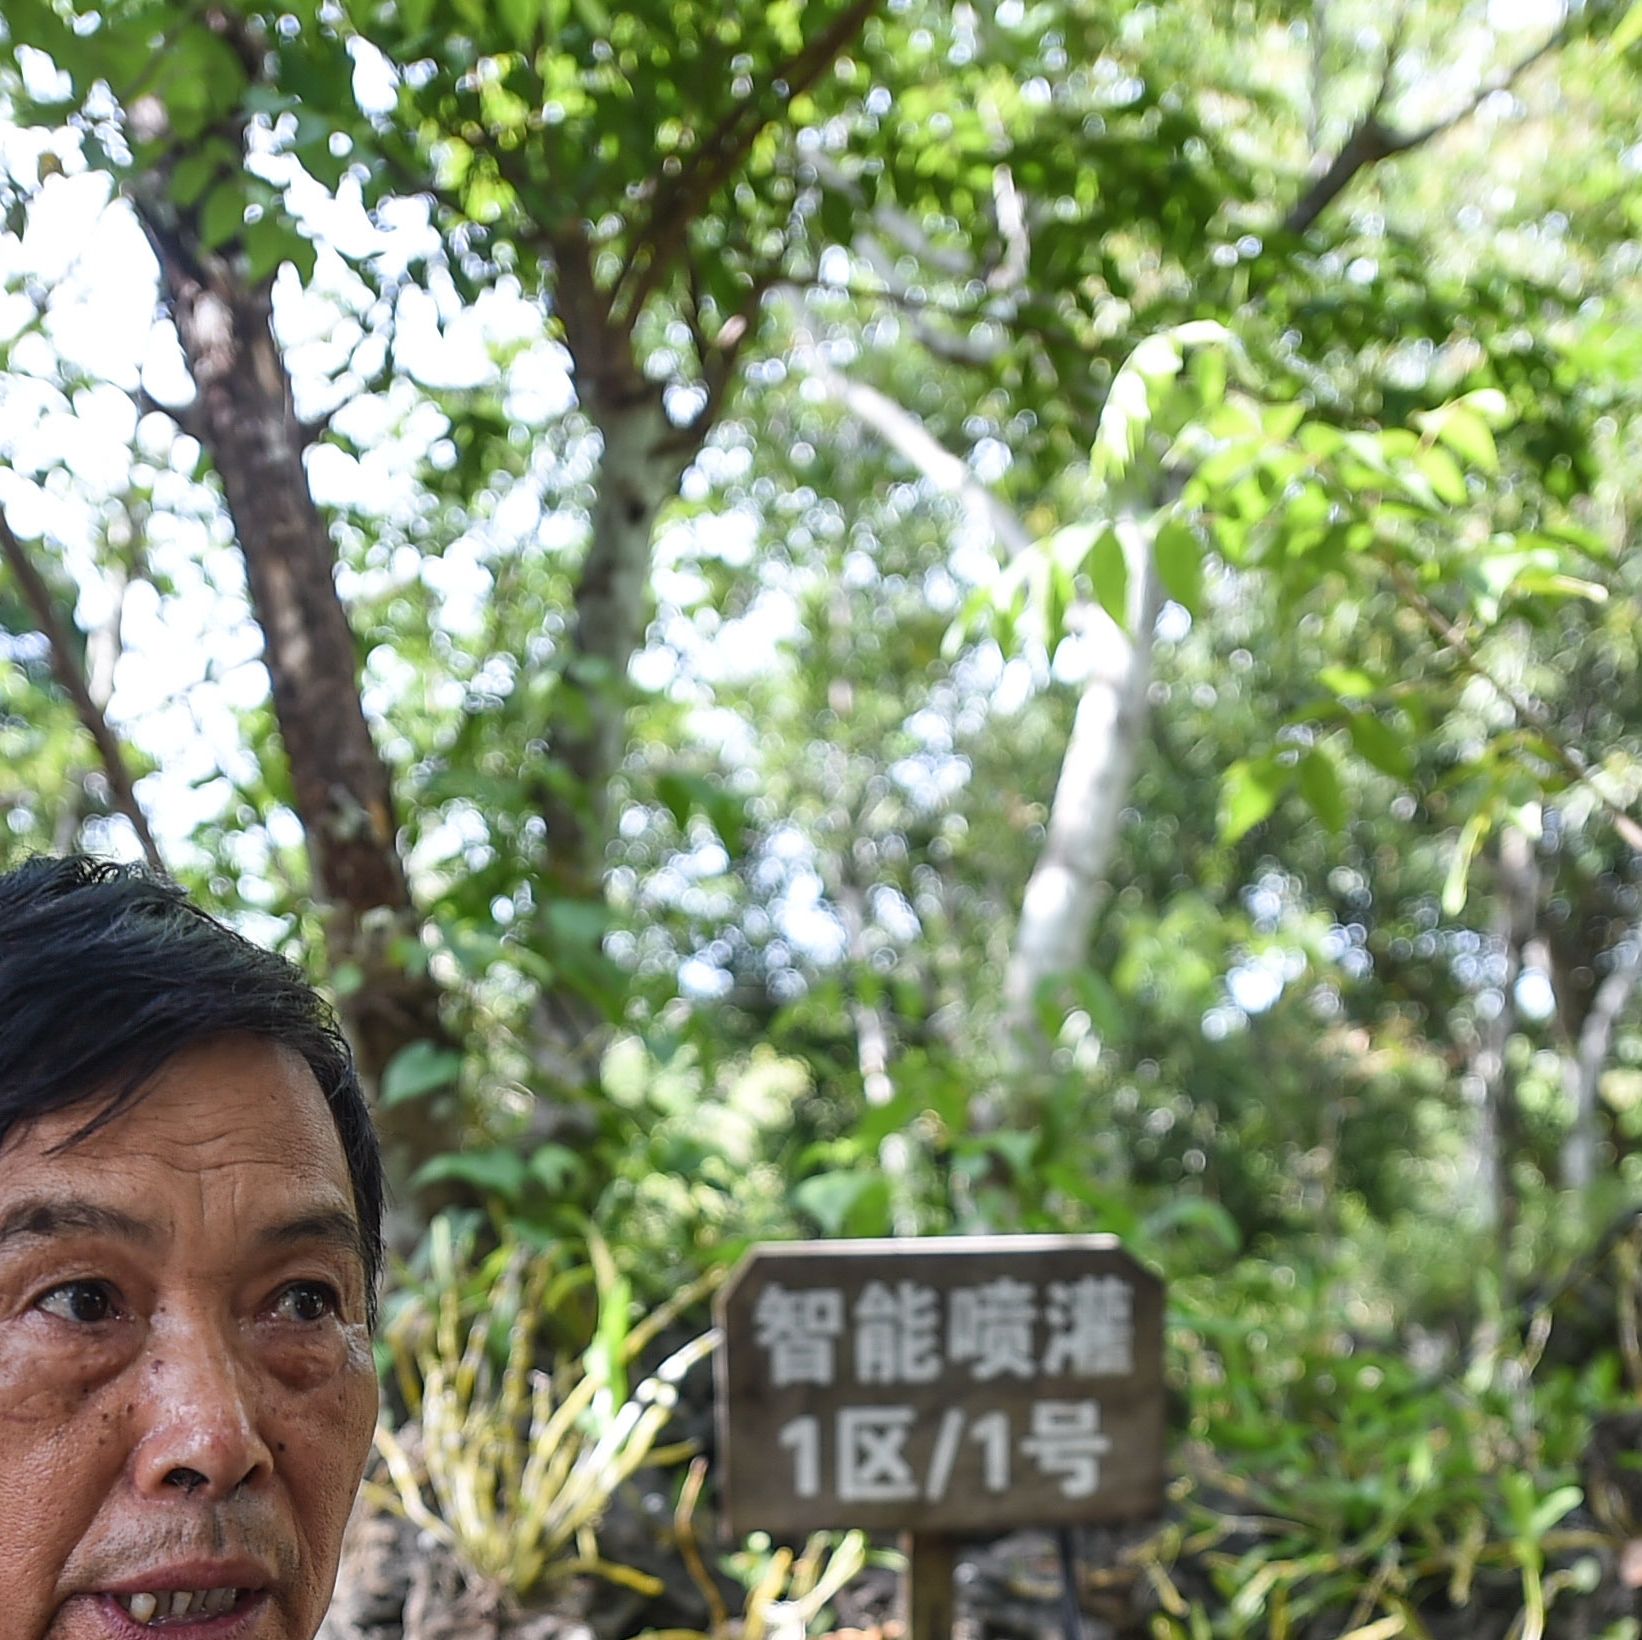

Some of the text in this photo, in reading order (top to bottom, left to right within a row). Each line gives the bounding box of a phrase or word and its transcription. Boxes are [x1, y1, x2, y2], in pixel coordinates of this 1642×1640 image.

[753, 1273, 1134, 1387] 智能喷灌
[779, 1399, 1113, 1502] 1区/1号
